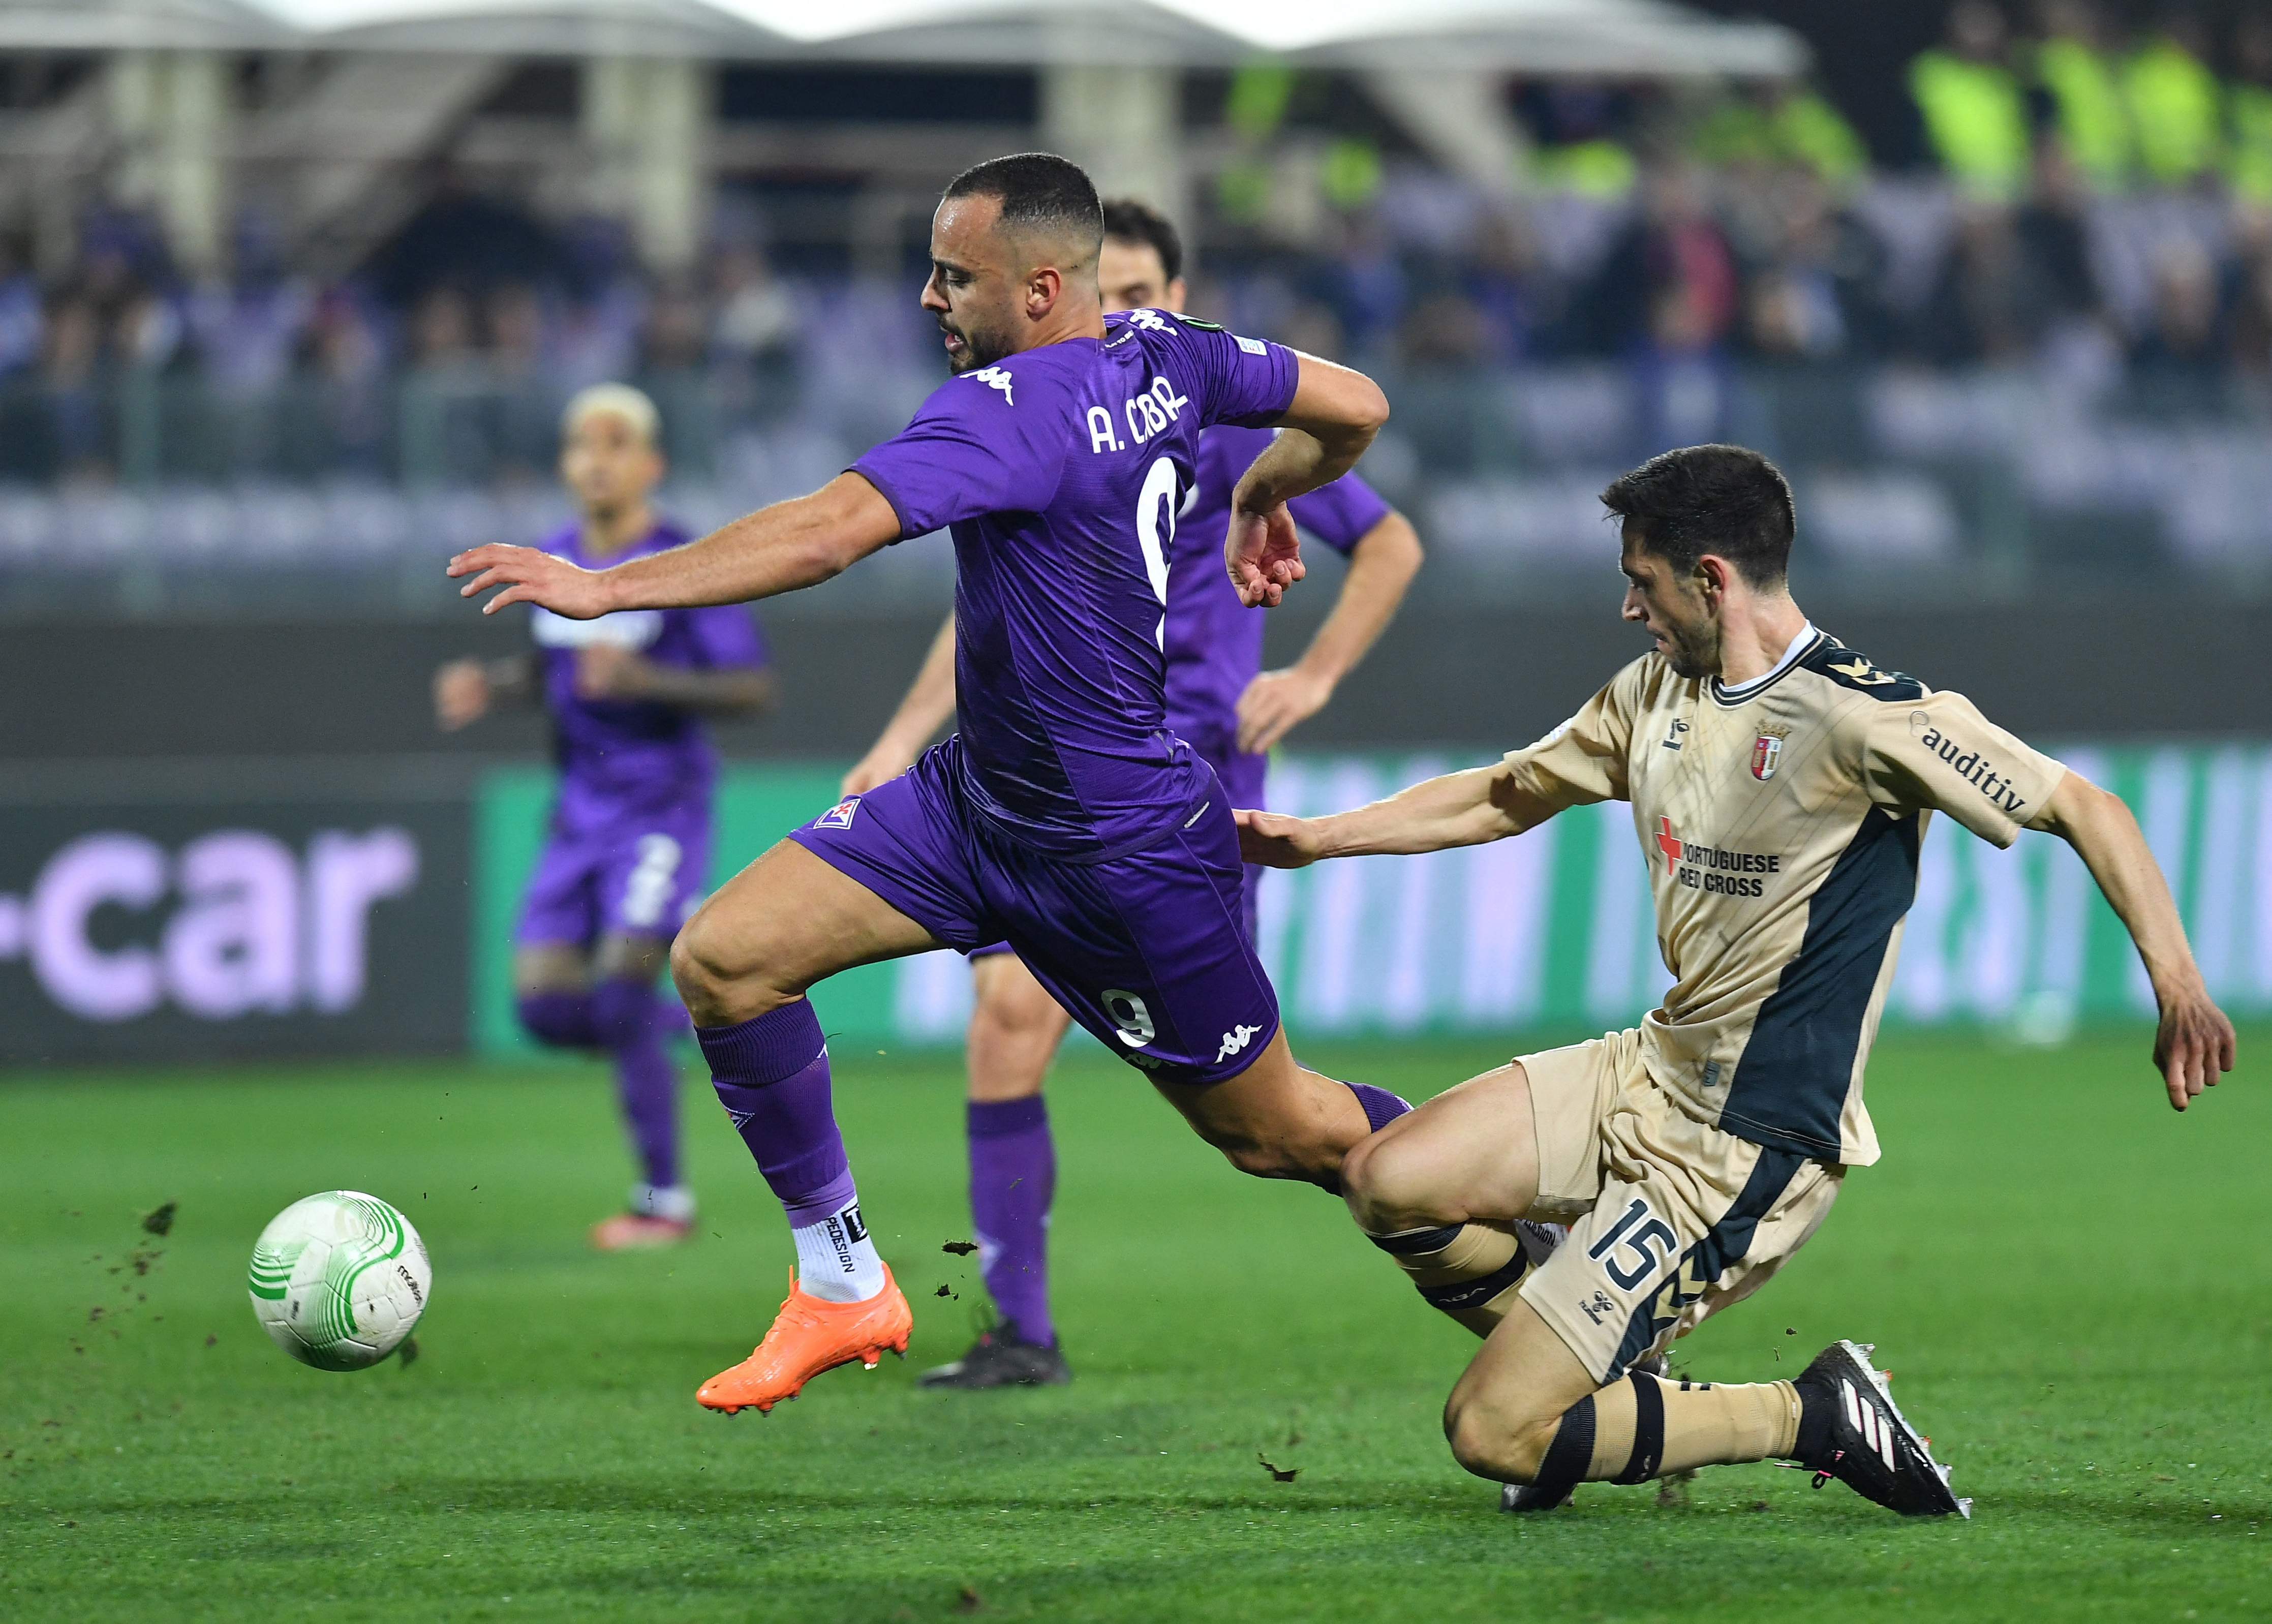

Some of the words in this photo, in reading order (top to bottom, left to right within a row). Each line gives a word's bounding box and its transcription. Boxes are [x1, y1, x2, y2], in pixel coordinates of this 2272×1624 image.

[1087, 406, 1125, 453] A.
[1922, 727, 2026, 812] auditiv
[1680, 866, 1701, 889] RED
[1705, 872, 1764, 897] CROSS
[1100, 989, 1155, 1048] 9
[1589, 1197, 1680, 1294] 15
